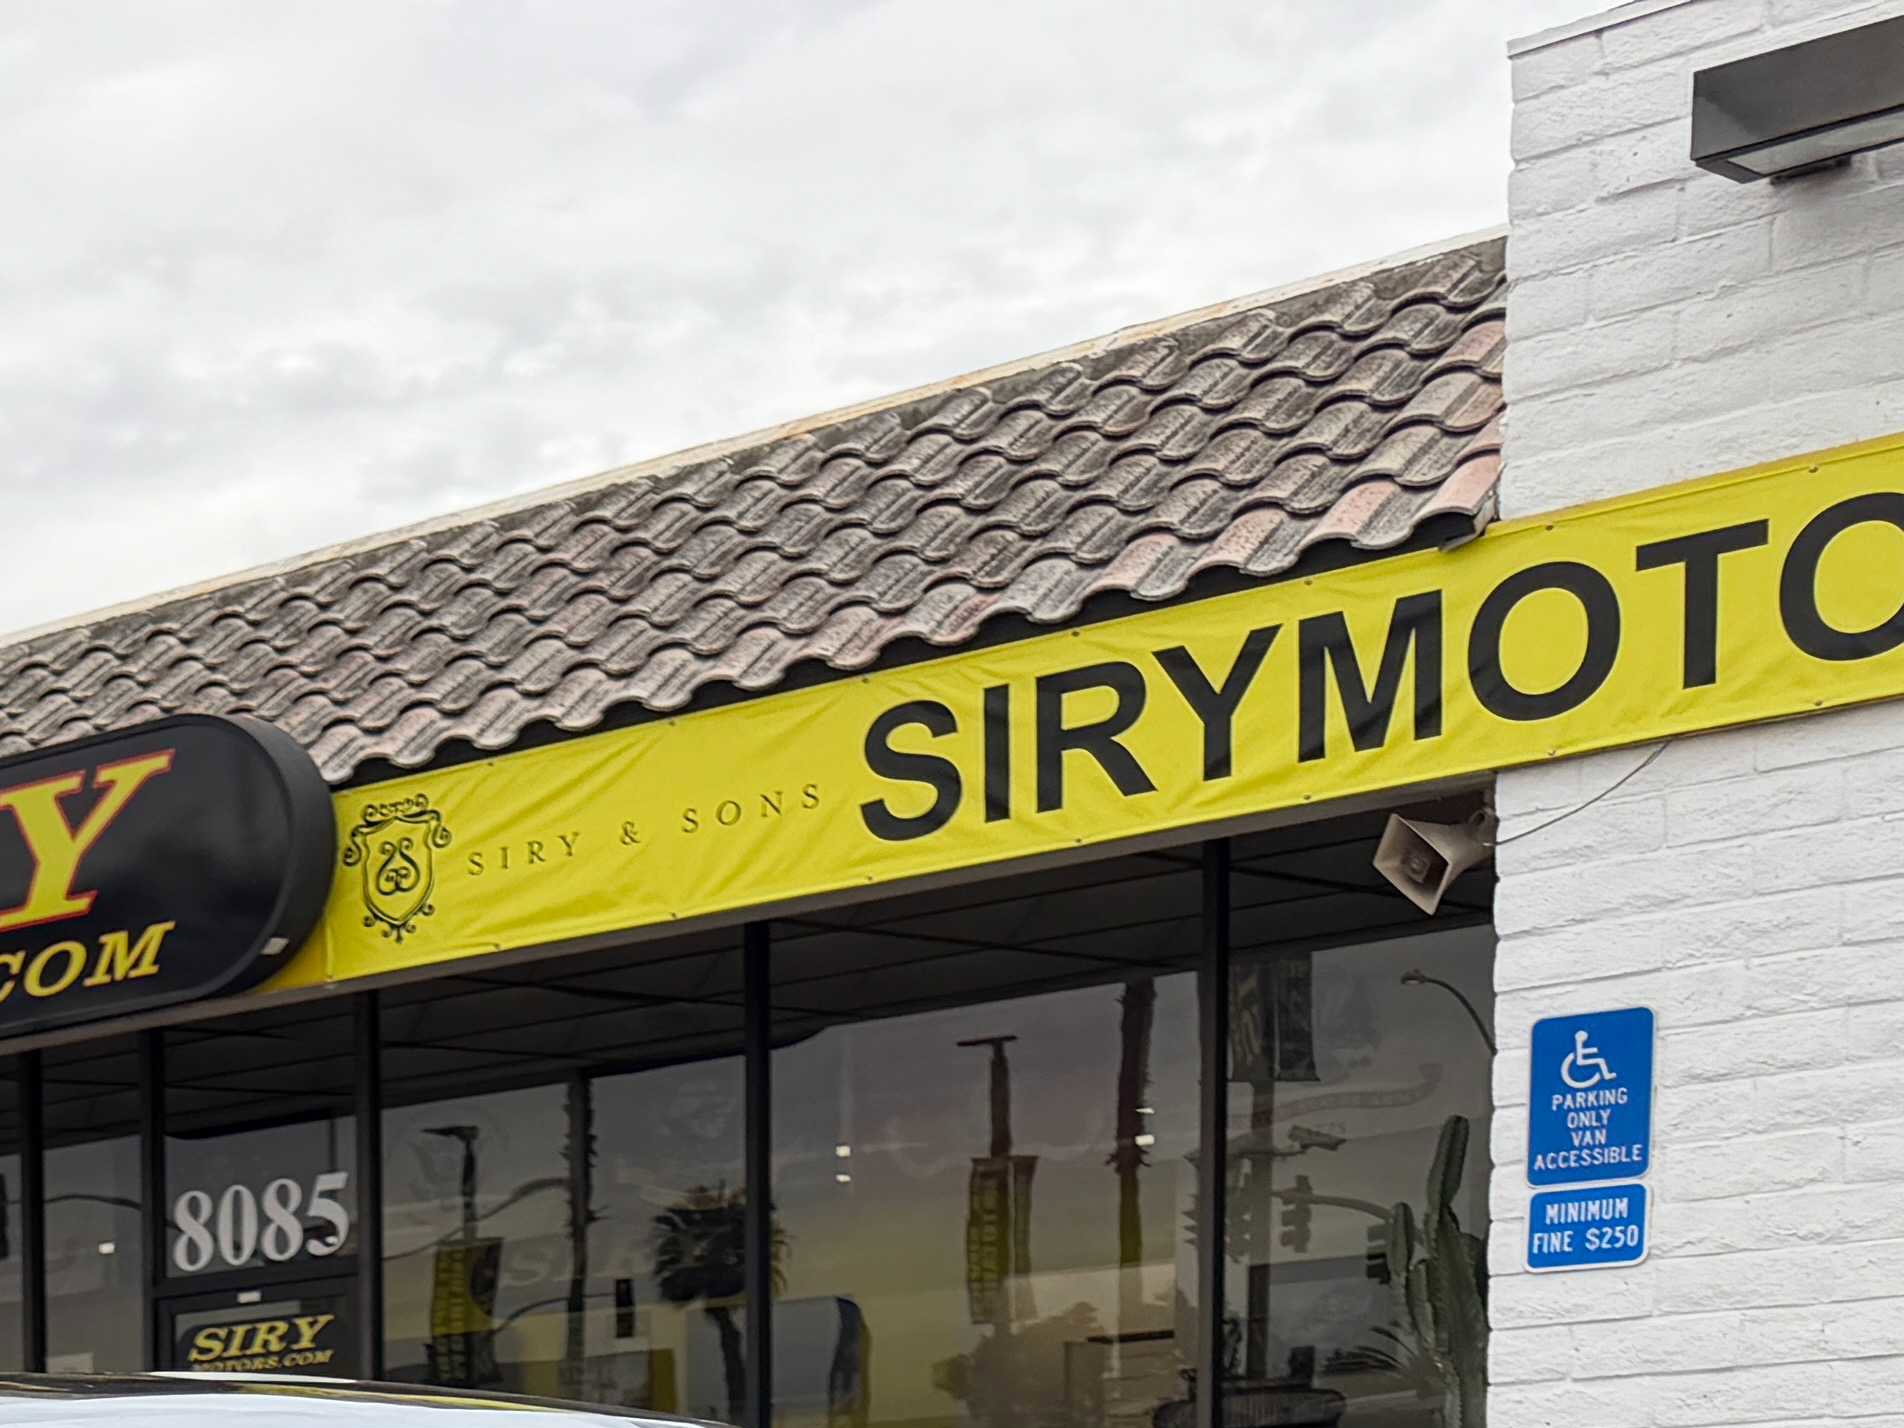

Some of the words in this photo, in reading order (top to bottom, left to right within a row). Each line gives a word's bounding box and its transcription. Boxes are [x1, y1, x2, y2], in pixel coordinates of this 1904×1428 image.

[467, 832, 580, 876] SIRY
[620, 820, 641, 846] &
[681, 784, 821, 834] SONS
[1552, 1087, 1628, 1111] PARKING
[1567, 1109, 1611, 1128] ONLY
[1571, 1129, 1607, 1147] VAN
[1534, 1144, 1642, 1170] ACCESSIBLE
[173, 1171, 350, 1272] 8085
[1545, 1197, 1629, 1224] MINIMUM
[1532, 1231, 1573, 1254] FINE
[1585, 1225, 1639, 1250] $250
[188, 1314, 335, 1361] SIRY
